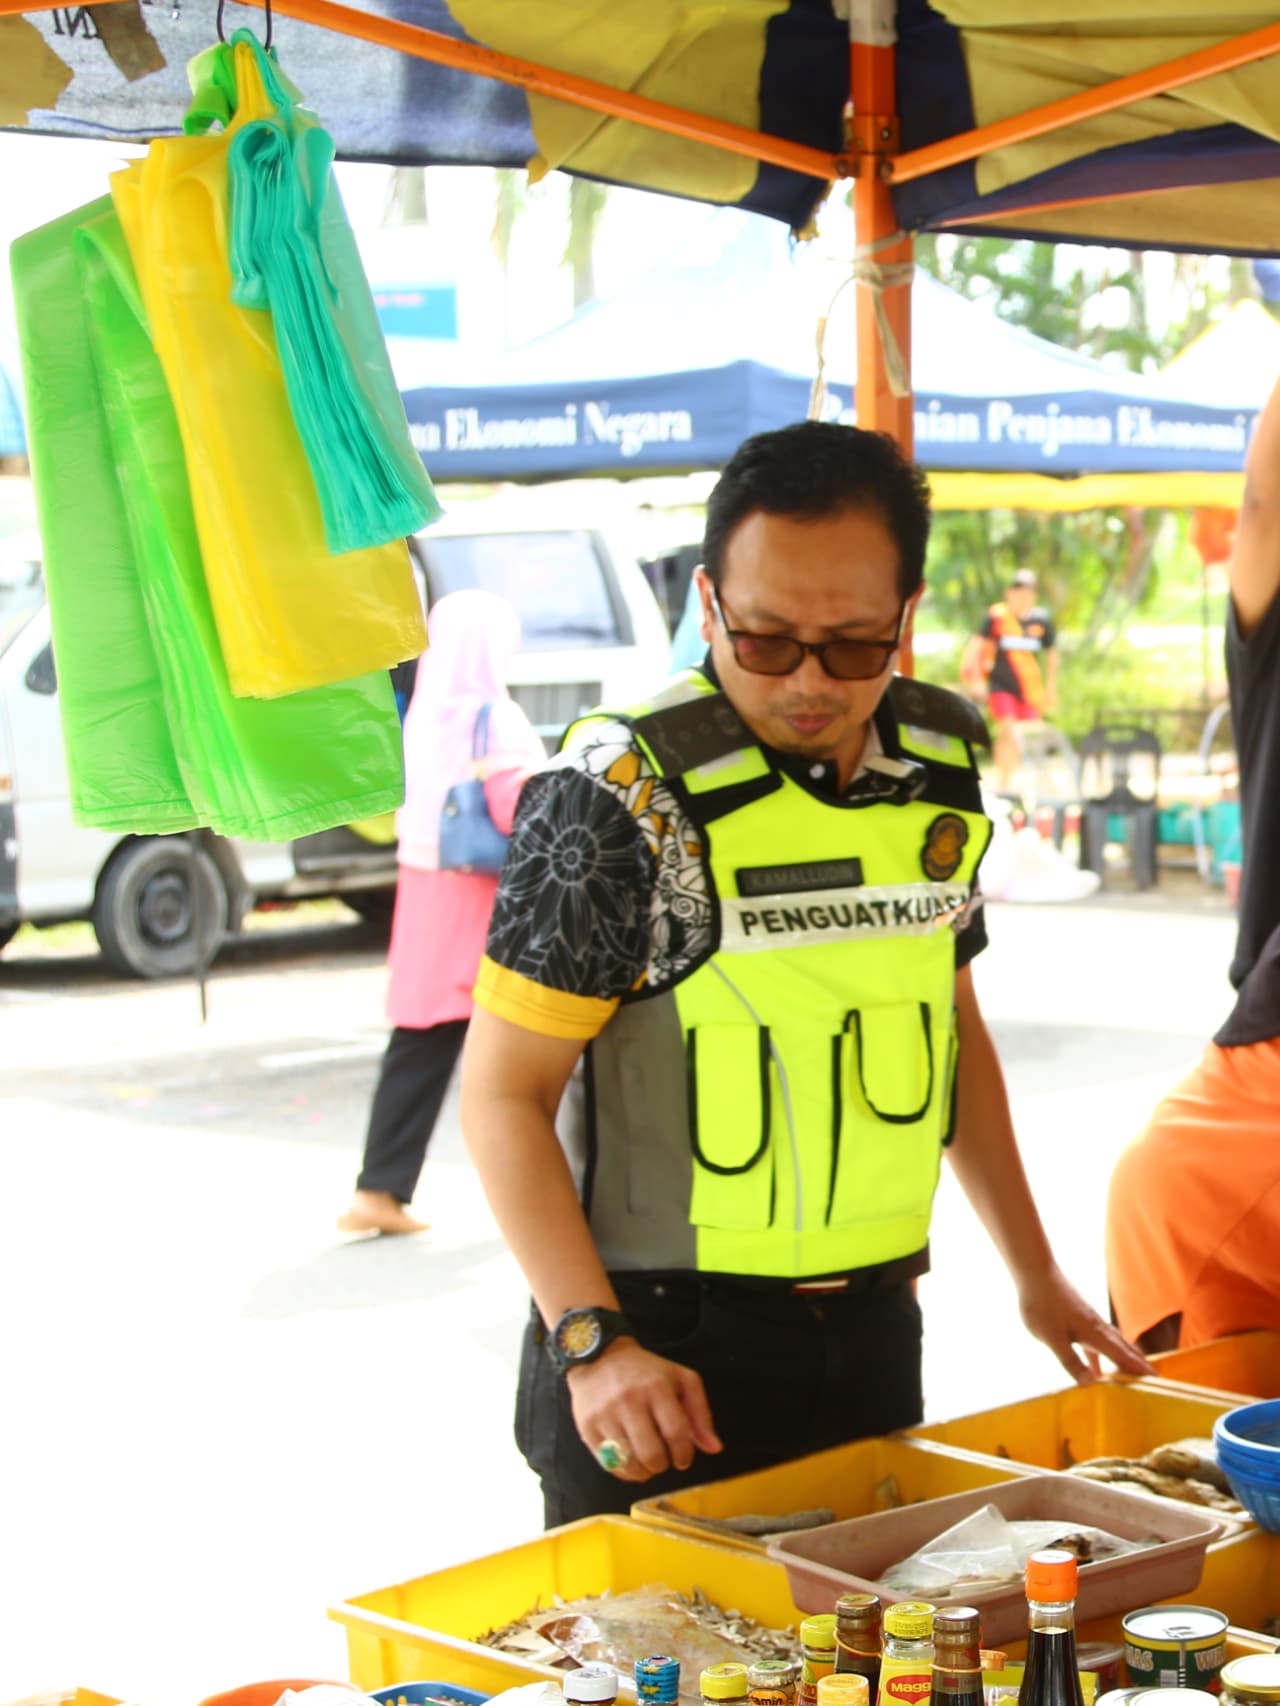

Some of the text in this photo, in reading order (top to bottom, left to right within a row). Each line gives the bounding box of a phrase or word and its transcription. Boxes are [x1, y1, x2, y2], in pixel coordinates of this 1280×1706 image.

[445, 403, 577, 452] Ekonomi
[584, 400, 692, 458] Negara
[987, 399, 1111, 457] Penjana
[1117, 404, 1246, 452] Ekonomi
[891, 1682, 931, 1694] Magg
